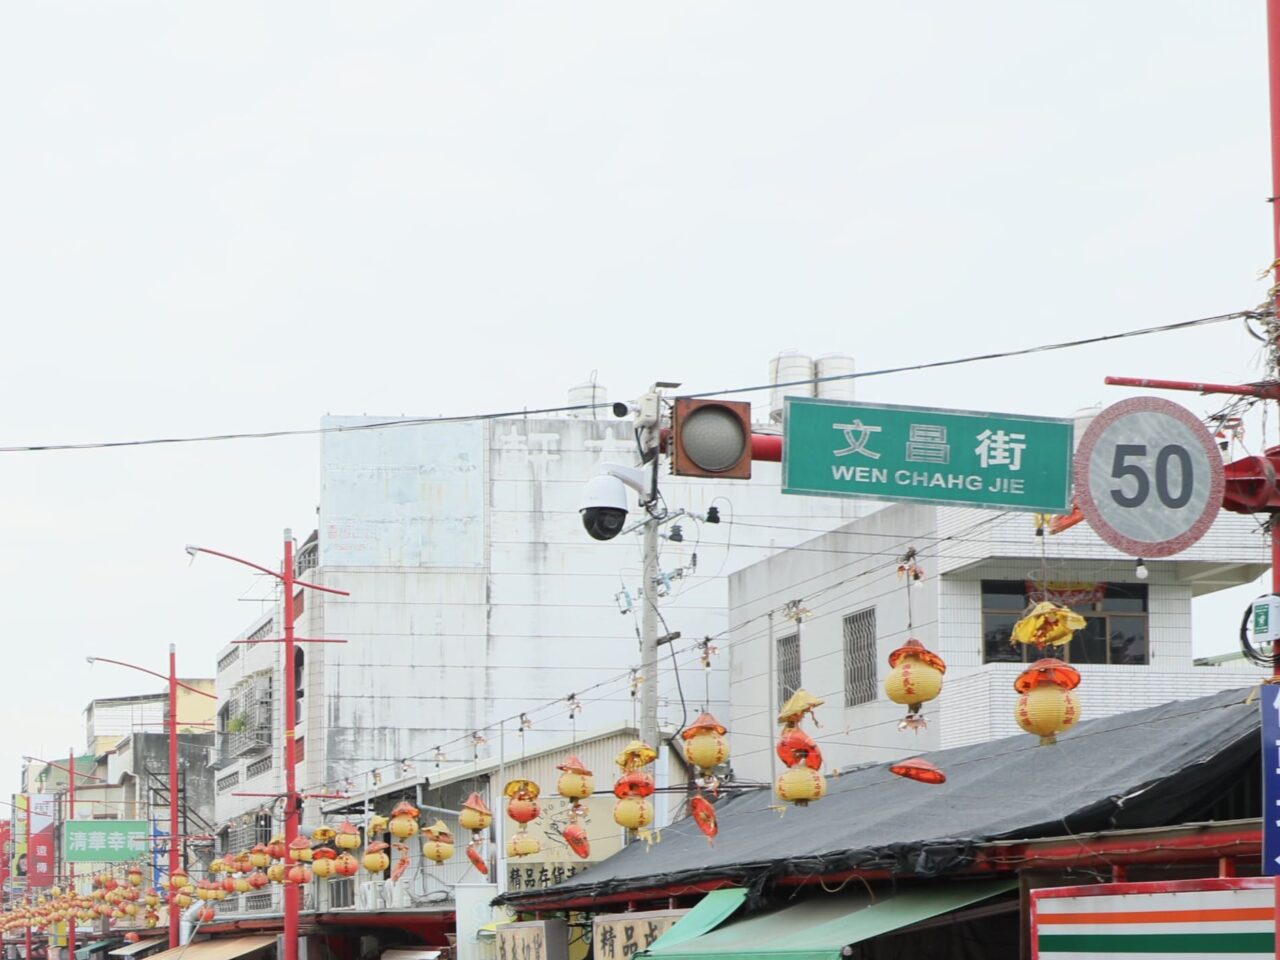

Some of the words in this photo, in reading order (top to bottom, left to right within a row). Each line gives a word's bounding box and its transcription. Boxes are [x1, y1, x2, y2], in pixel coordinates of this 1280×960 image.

[832, 419, 1027, 473] 文昌街
[831, 465, 888, 483] WEN
[988, 478, 1025, 494] JIE
[1109, 443, 1194, 509] 50
[509, 866, 589, 889] 精品存貨
[600, 921, 676, 960] 精品成
